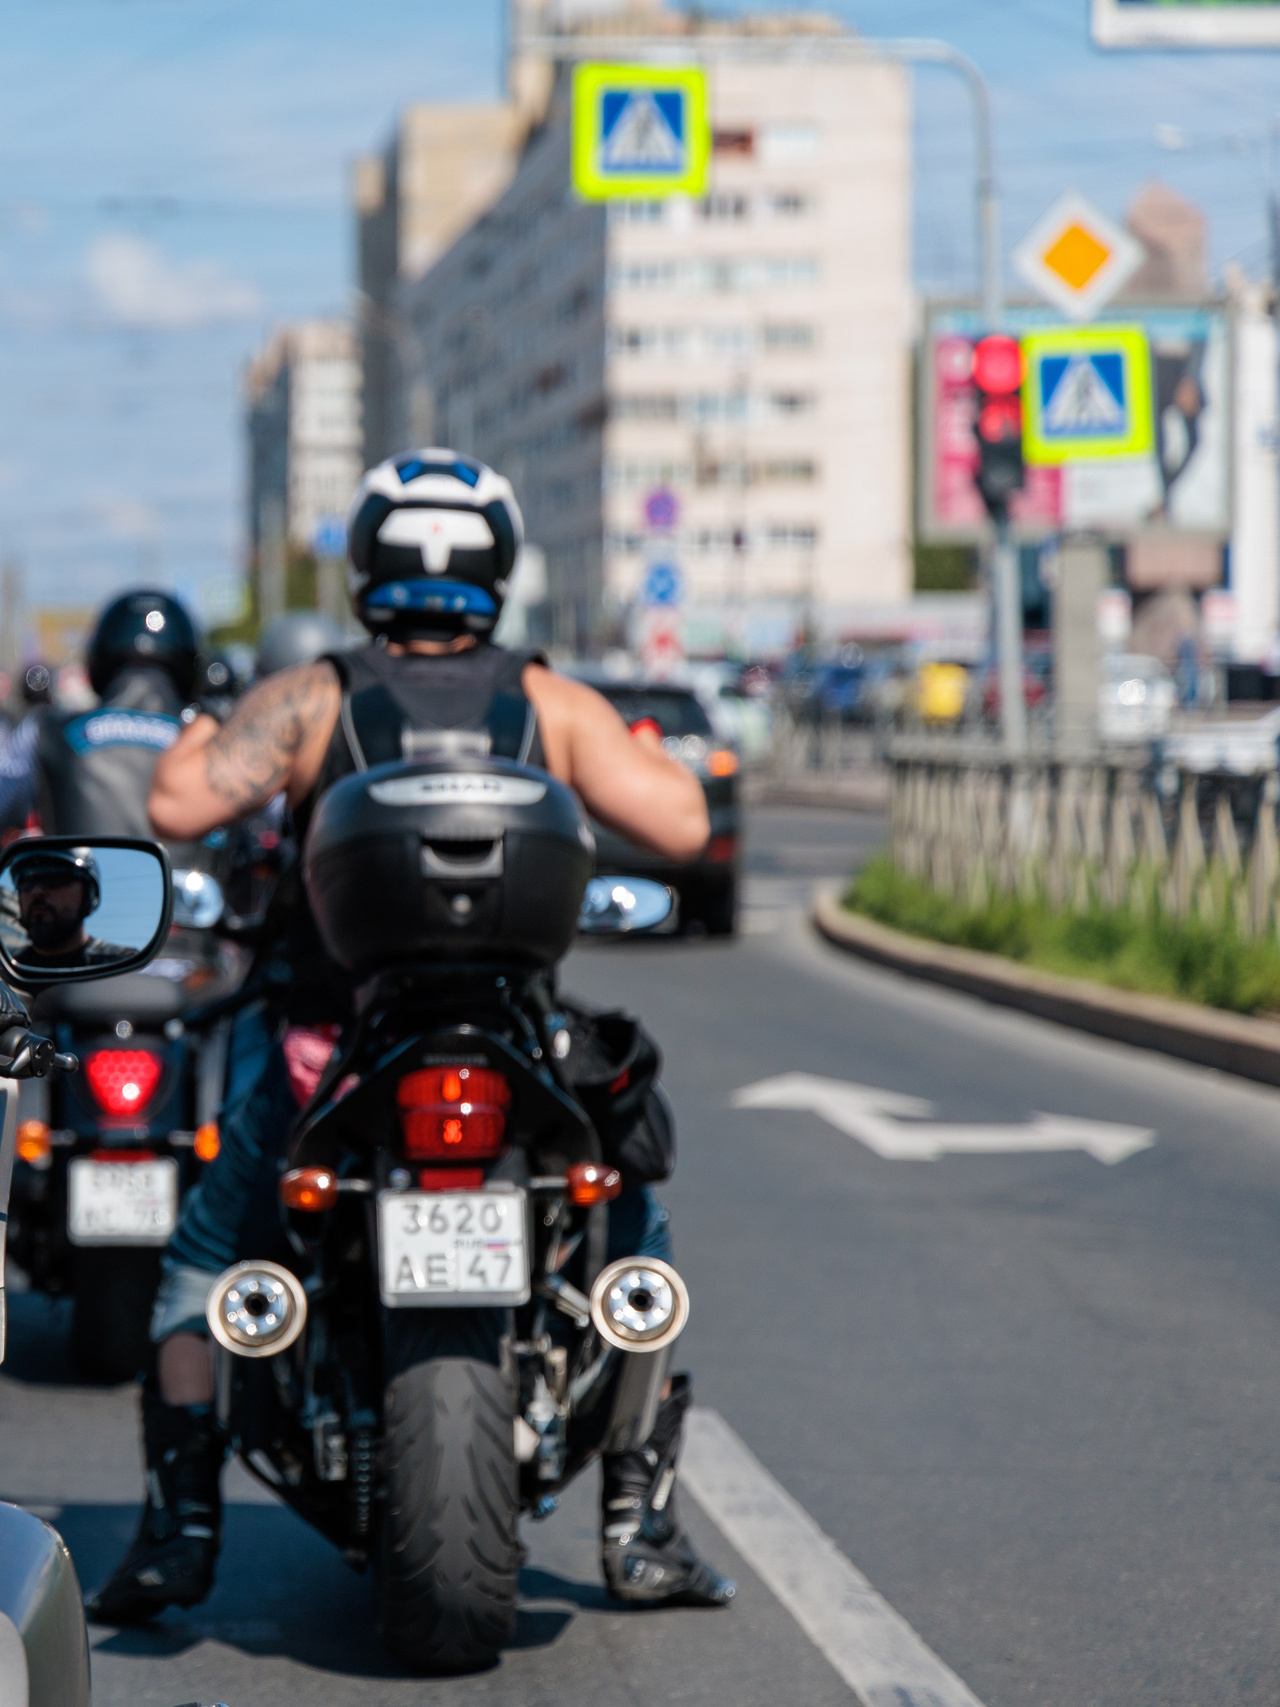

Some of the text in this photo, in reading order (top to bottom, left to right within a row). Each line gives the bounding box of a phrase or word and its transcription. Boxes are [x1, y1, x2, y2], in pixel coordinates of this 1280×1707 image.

[402, 1202, 502, 1235] 3620
[395, 1253, 513, 1288] AE 47
